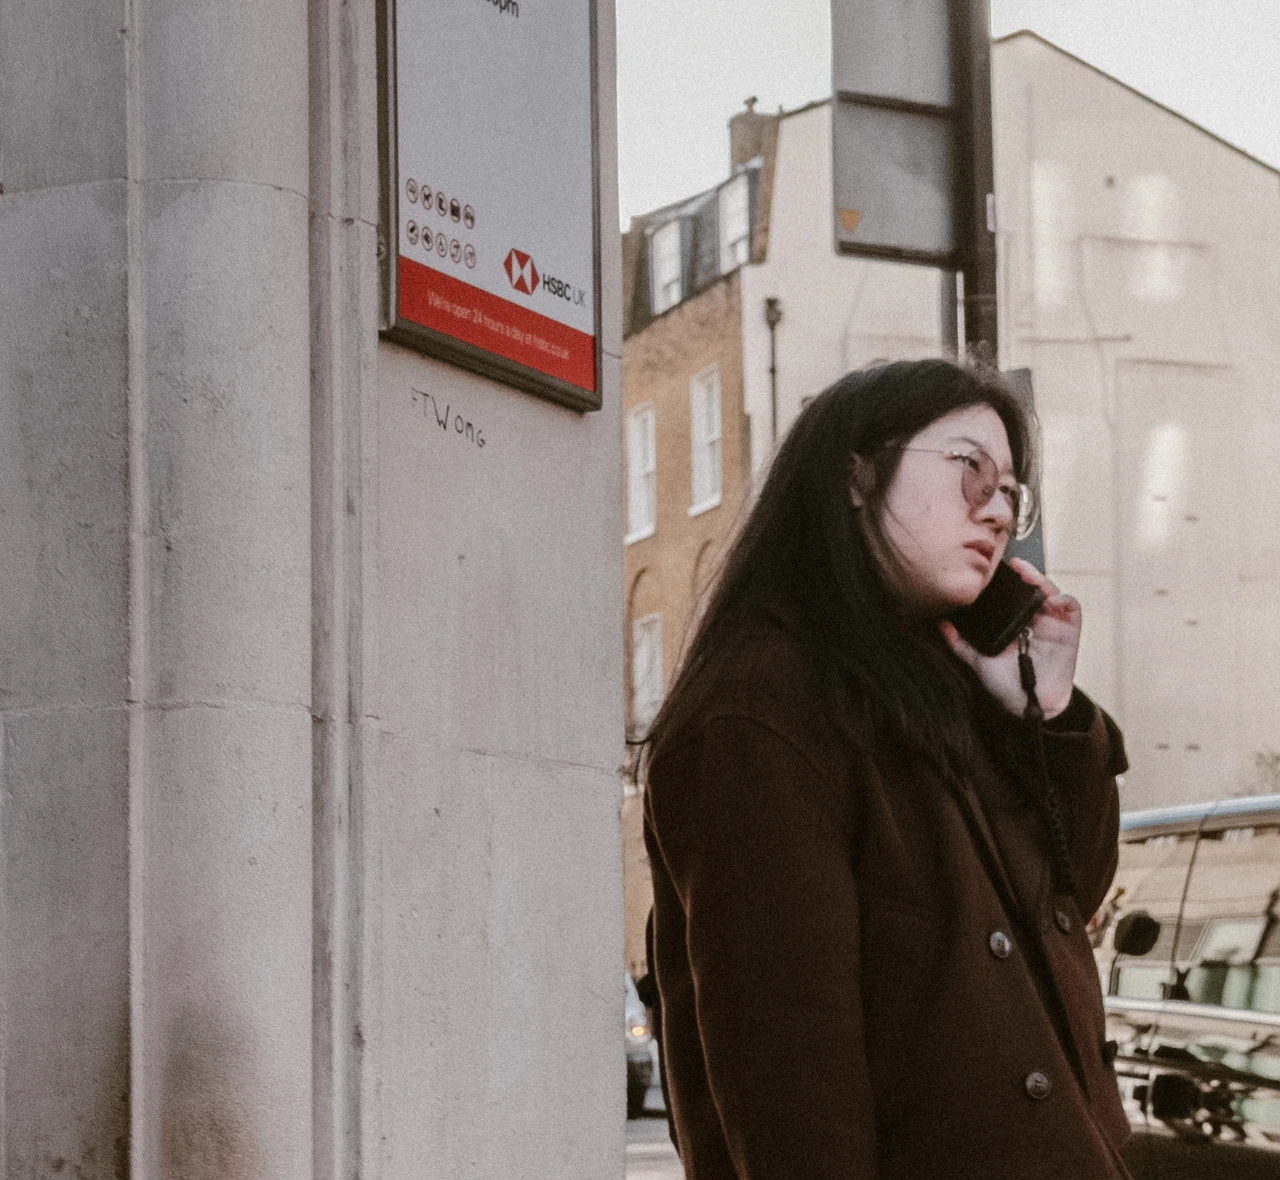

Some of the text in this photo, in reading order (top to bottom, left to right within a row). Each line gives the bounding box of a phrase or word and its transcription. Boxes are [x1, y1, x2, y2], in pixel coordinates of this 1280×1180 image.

[542, 273, 587, 308] HSBC UK
[472, 308, 482, 324] 24
